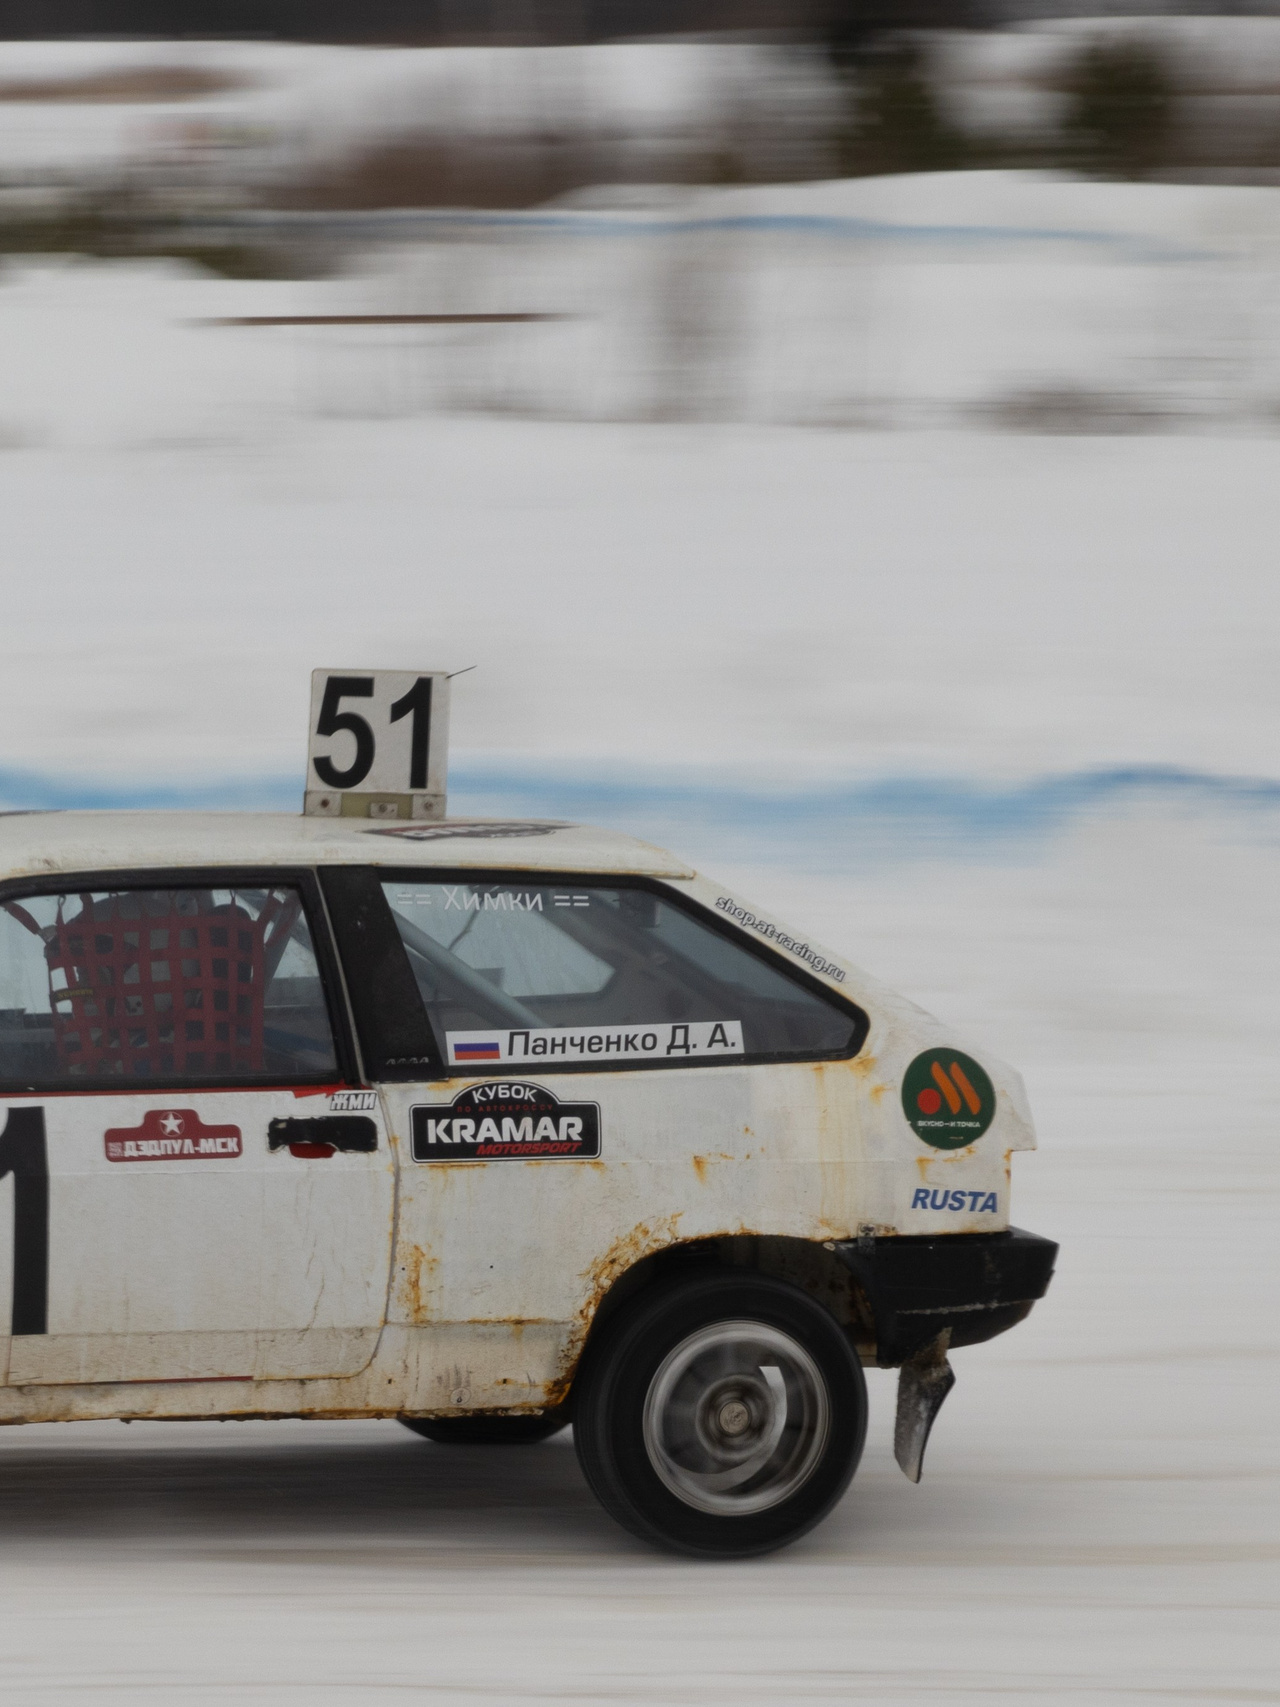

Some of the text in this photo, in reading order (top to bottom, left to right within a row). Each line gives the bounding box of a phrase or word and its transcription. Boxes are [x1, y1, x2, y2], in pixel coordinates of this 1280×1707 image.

[312, 675, 434, 790] 51
[441, 886, 543, 912] Химки
[716, 896, 846, 982] shop.at-racing.ru
[507, 1023, 736, 1056] Панченко Д. А.
[330, 1092, 378, 1111] ЖМИ
[472, 1084, 538, 1104] КУБОК
[426, 1116, 583, 1144] KRAMAR
[124, 1137, 239, 1158] ДЭДПУЛ-МСК
[476, 1142, 582, 1156] MOTORSPORT
[911, 1188, 998, 1213] RUSTA
